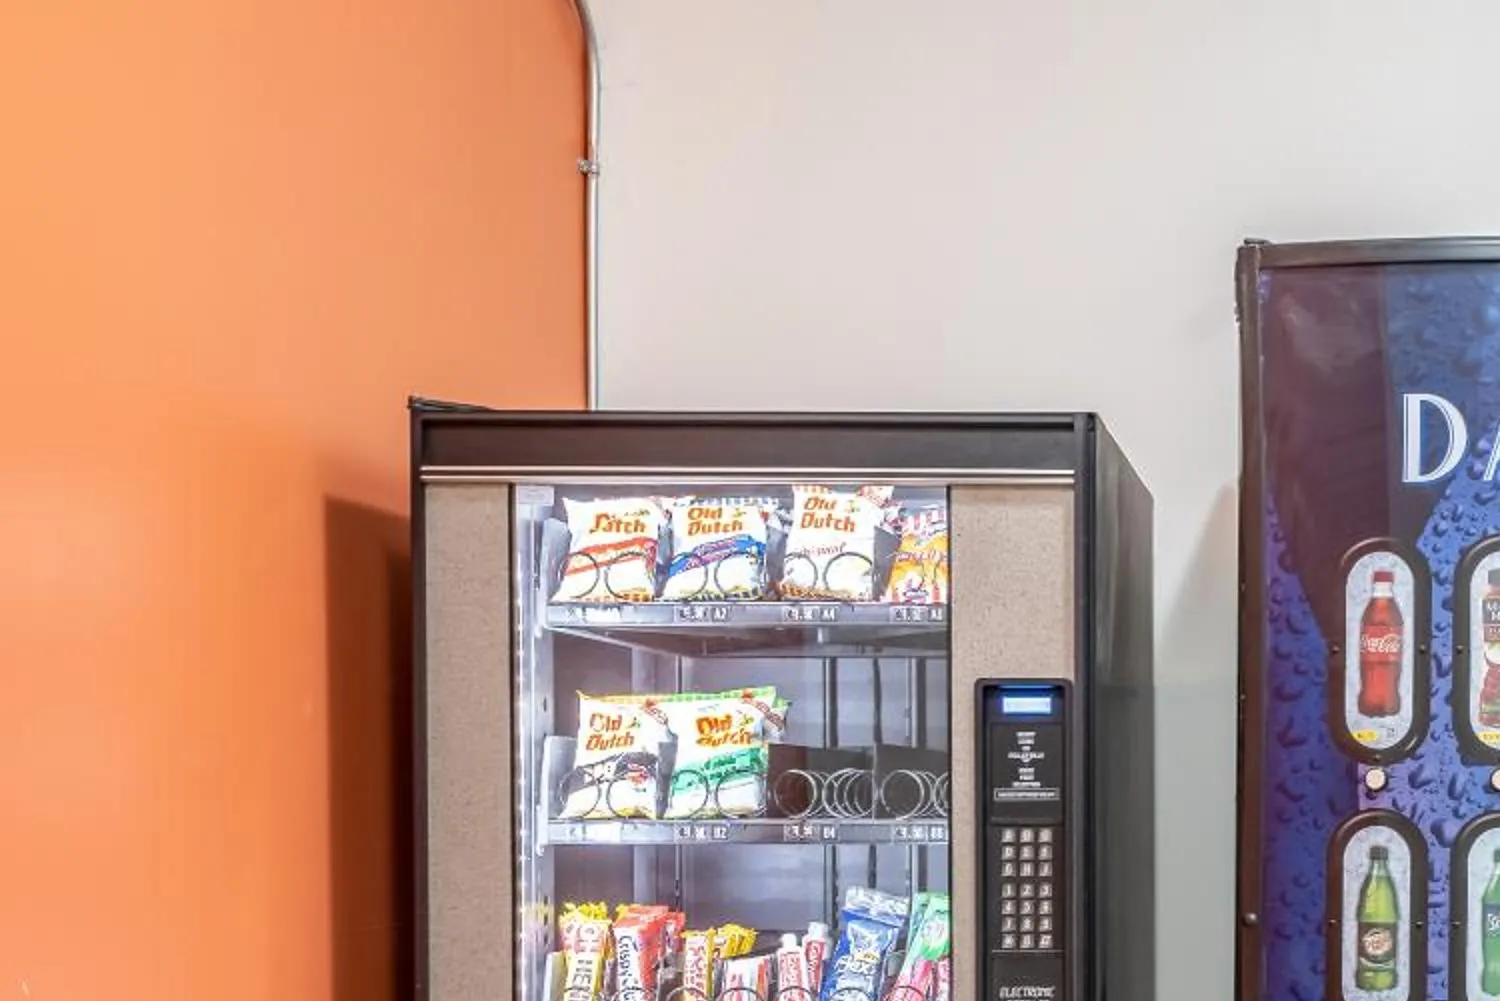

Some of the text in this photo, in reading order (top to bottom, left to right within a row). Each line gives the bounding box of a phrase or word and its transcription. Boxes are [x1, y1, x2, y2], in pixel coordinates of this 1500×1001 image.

[687, 507, 723, 520] Old
[801, 512, 856, 532] Dutch
[687, 520, 744, 537] Dutch
[586, 732, 634, 750] Dutch
[999, 985, 1056, 999] ELECTRONIC
